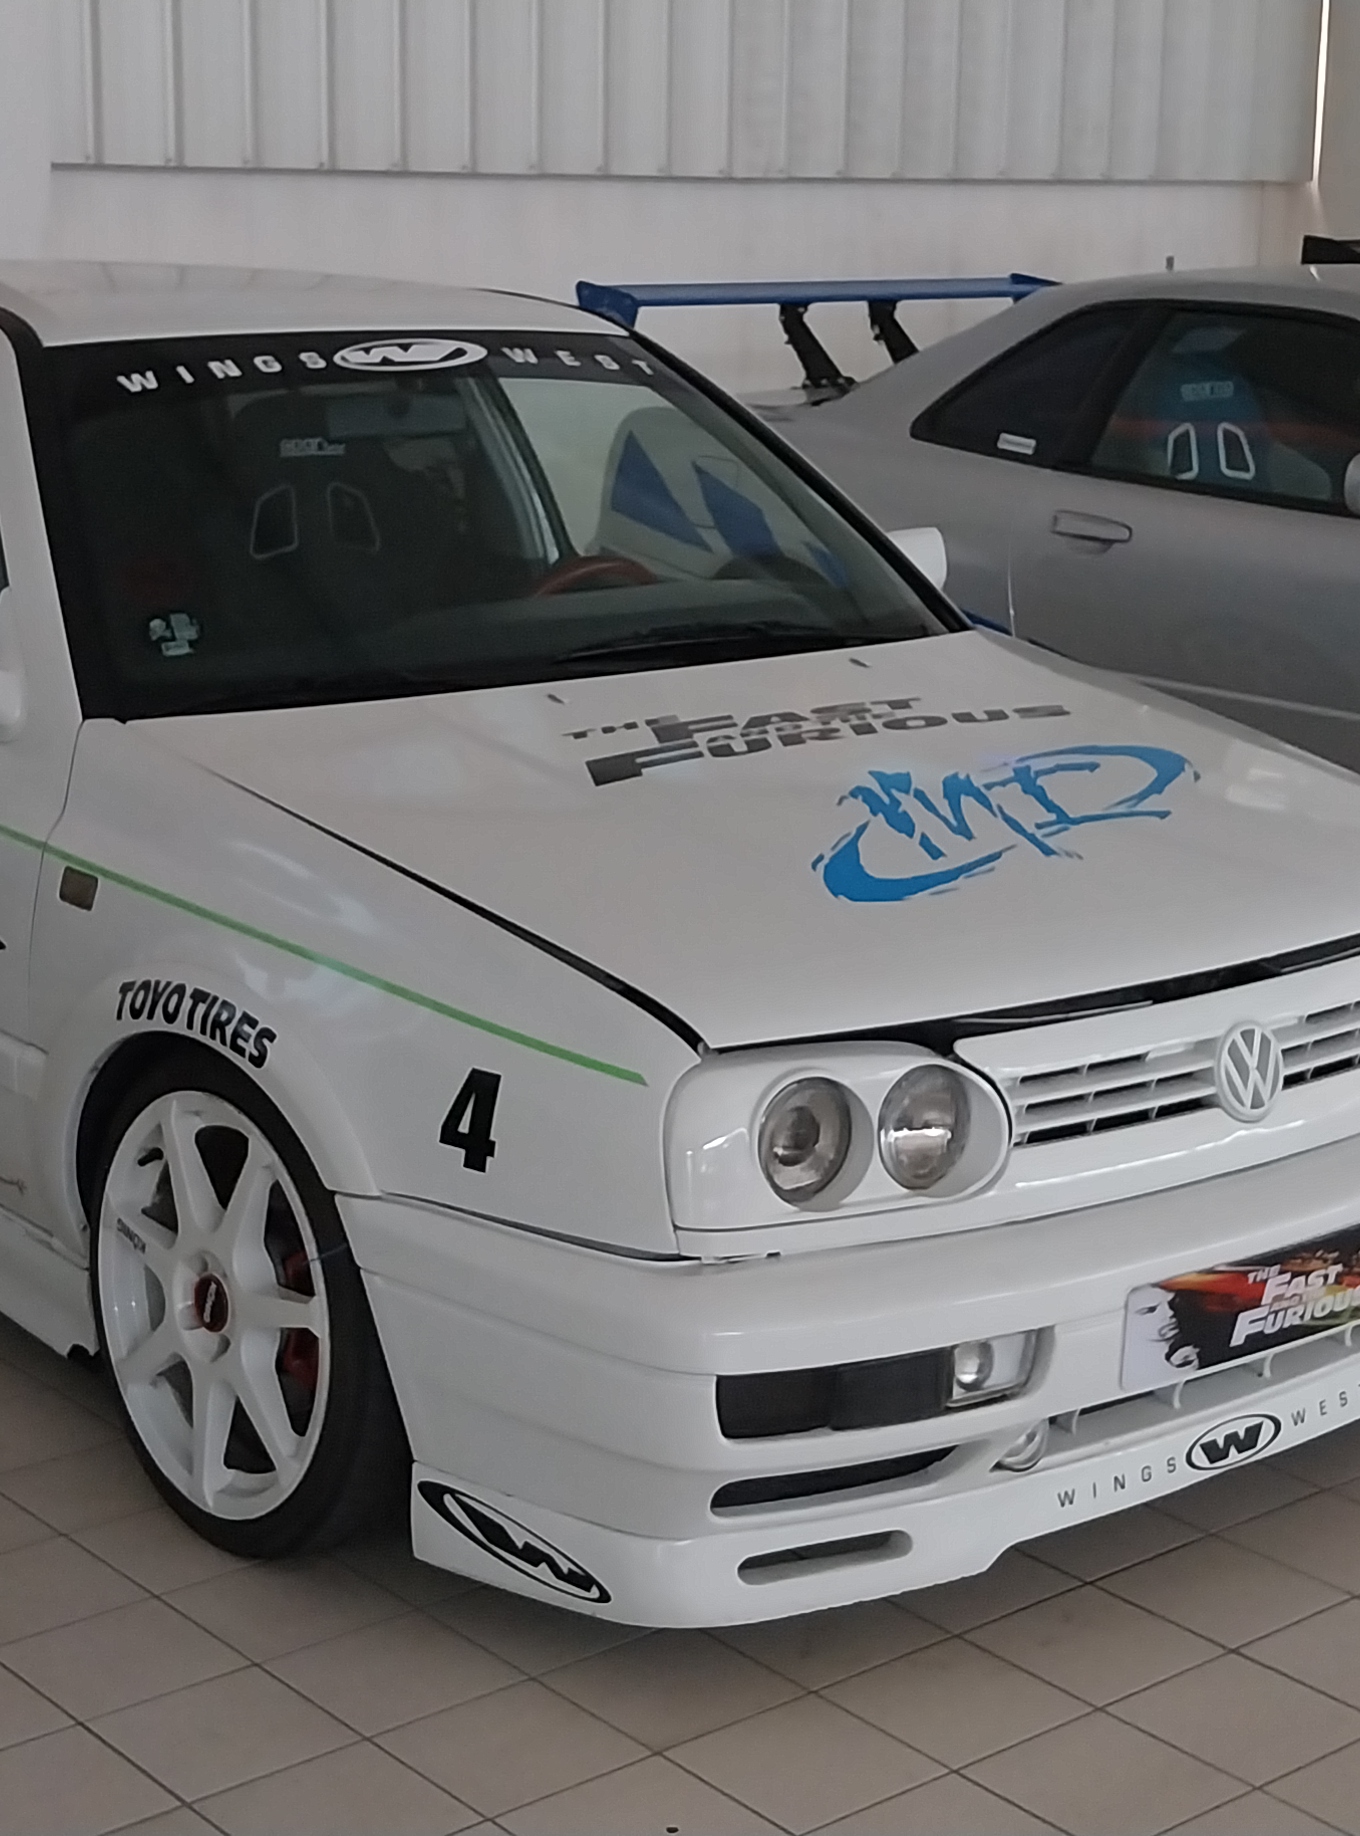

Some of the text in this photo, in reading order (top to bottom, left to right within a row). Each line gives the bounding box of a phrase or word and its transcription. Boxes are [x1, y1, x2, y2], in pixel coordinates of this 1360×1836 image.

[116, 351, 328, 393] WINGS
[501, 345, 655, 377] WEST
[650, 696, 922, 744] FAST
[585, 704, 1071, 787] FURIOUS
[115, 979, 278, 1070] TOYO TIRES
[439, 1067, 502, 1174] 4
[1247, 1263, 1282, 1285] THE
[1260, 1263, 1344, 1306] FAST
[1057, 1456, 1177, 1508] WINGS
